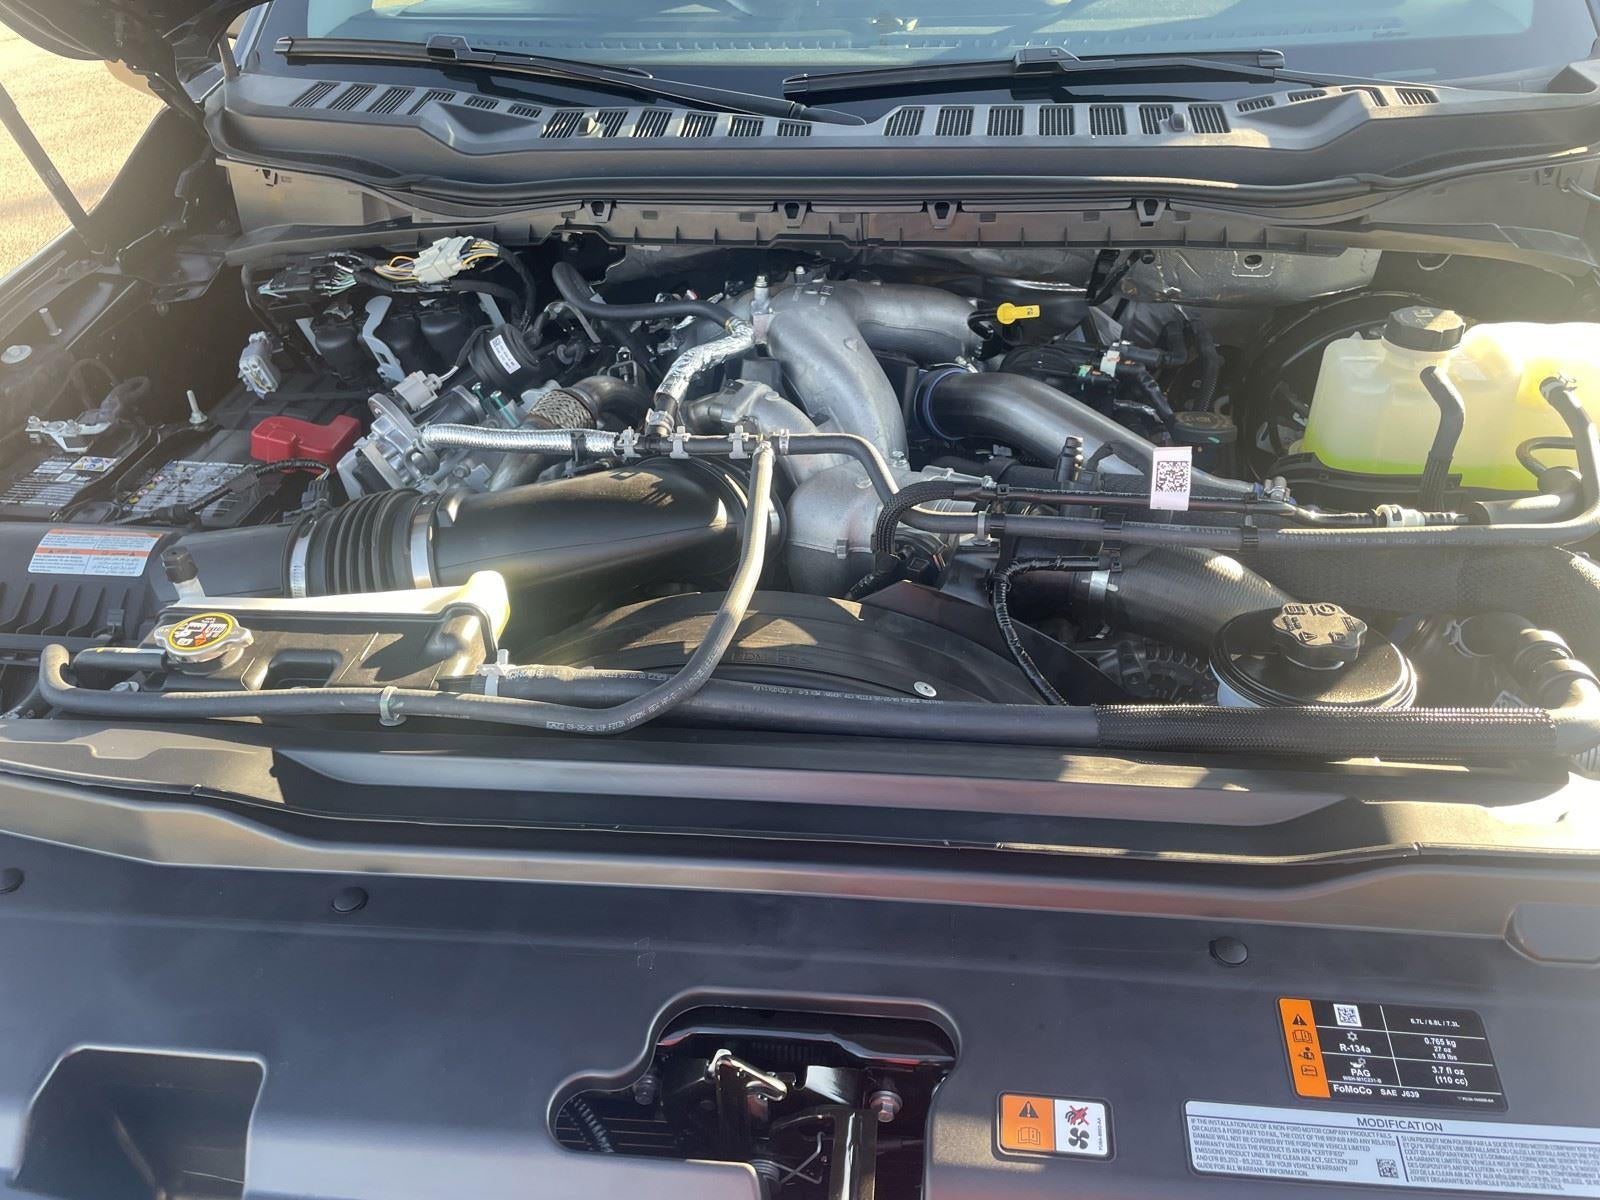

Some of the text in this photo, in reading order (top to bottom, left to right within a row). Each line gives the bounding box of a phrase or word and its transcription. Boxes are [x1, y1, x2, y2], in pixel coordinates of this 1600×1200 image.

[1424, 1037, 1456, 1048] 0.765 kg
[1340, 1044, 1371, 1054] R-134a
[1350, 1068, 1370, 1077] PAG
[1432, 1066, 1445, 1074] 3.7
[1435, 1076, 1468, 1086] (110 cc)
[1333, 1084, 1372, 1095] FoMoCo
[1357, 1117, 1443, 1132] MODIFICATION
